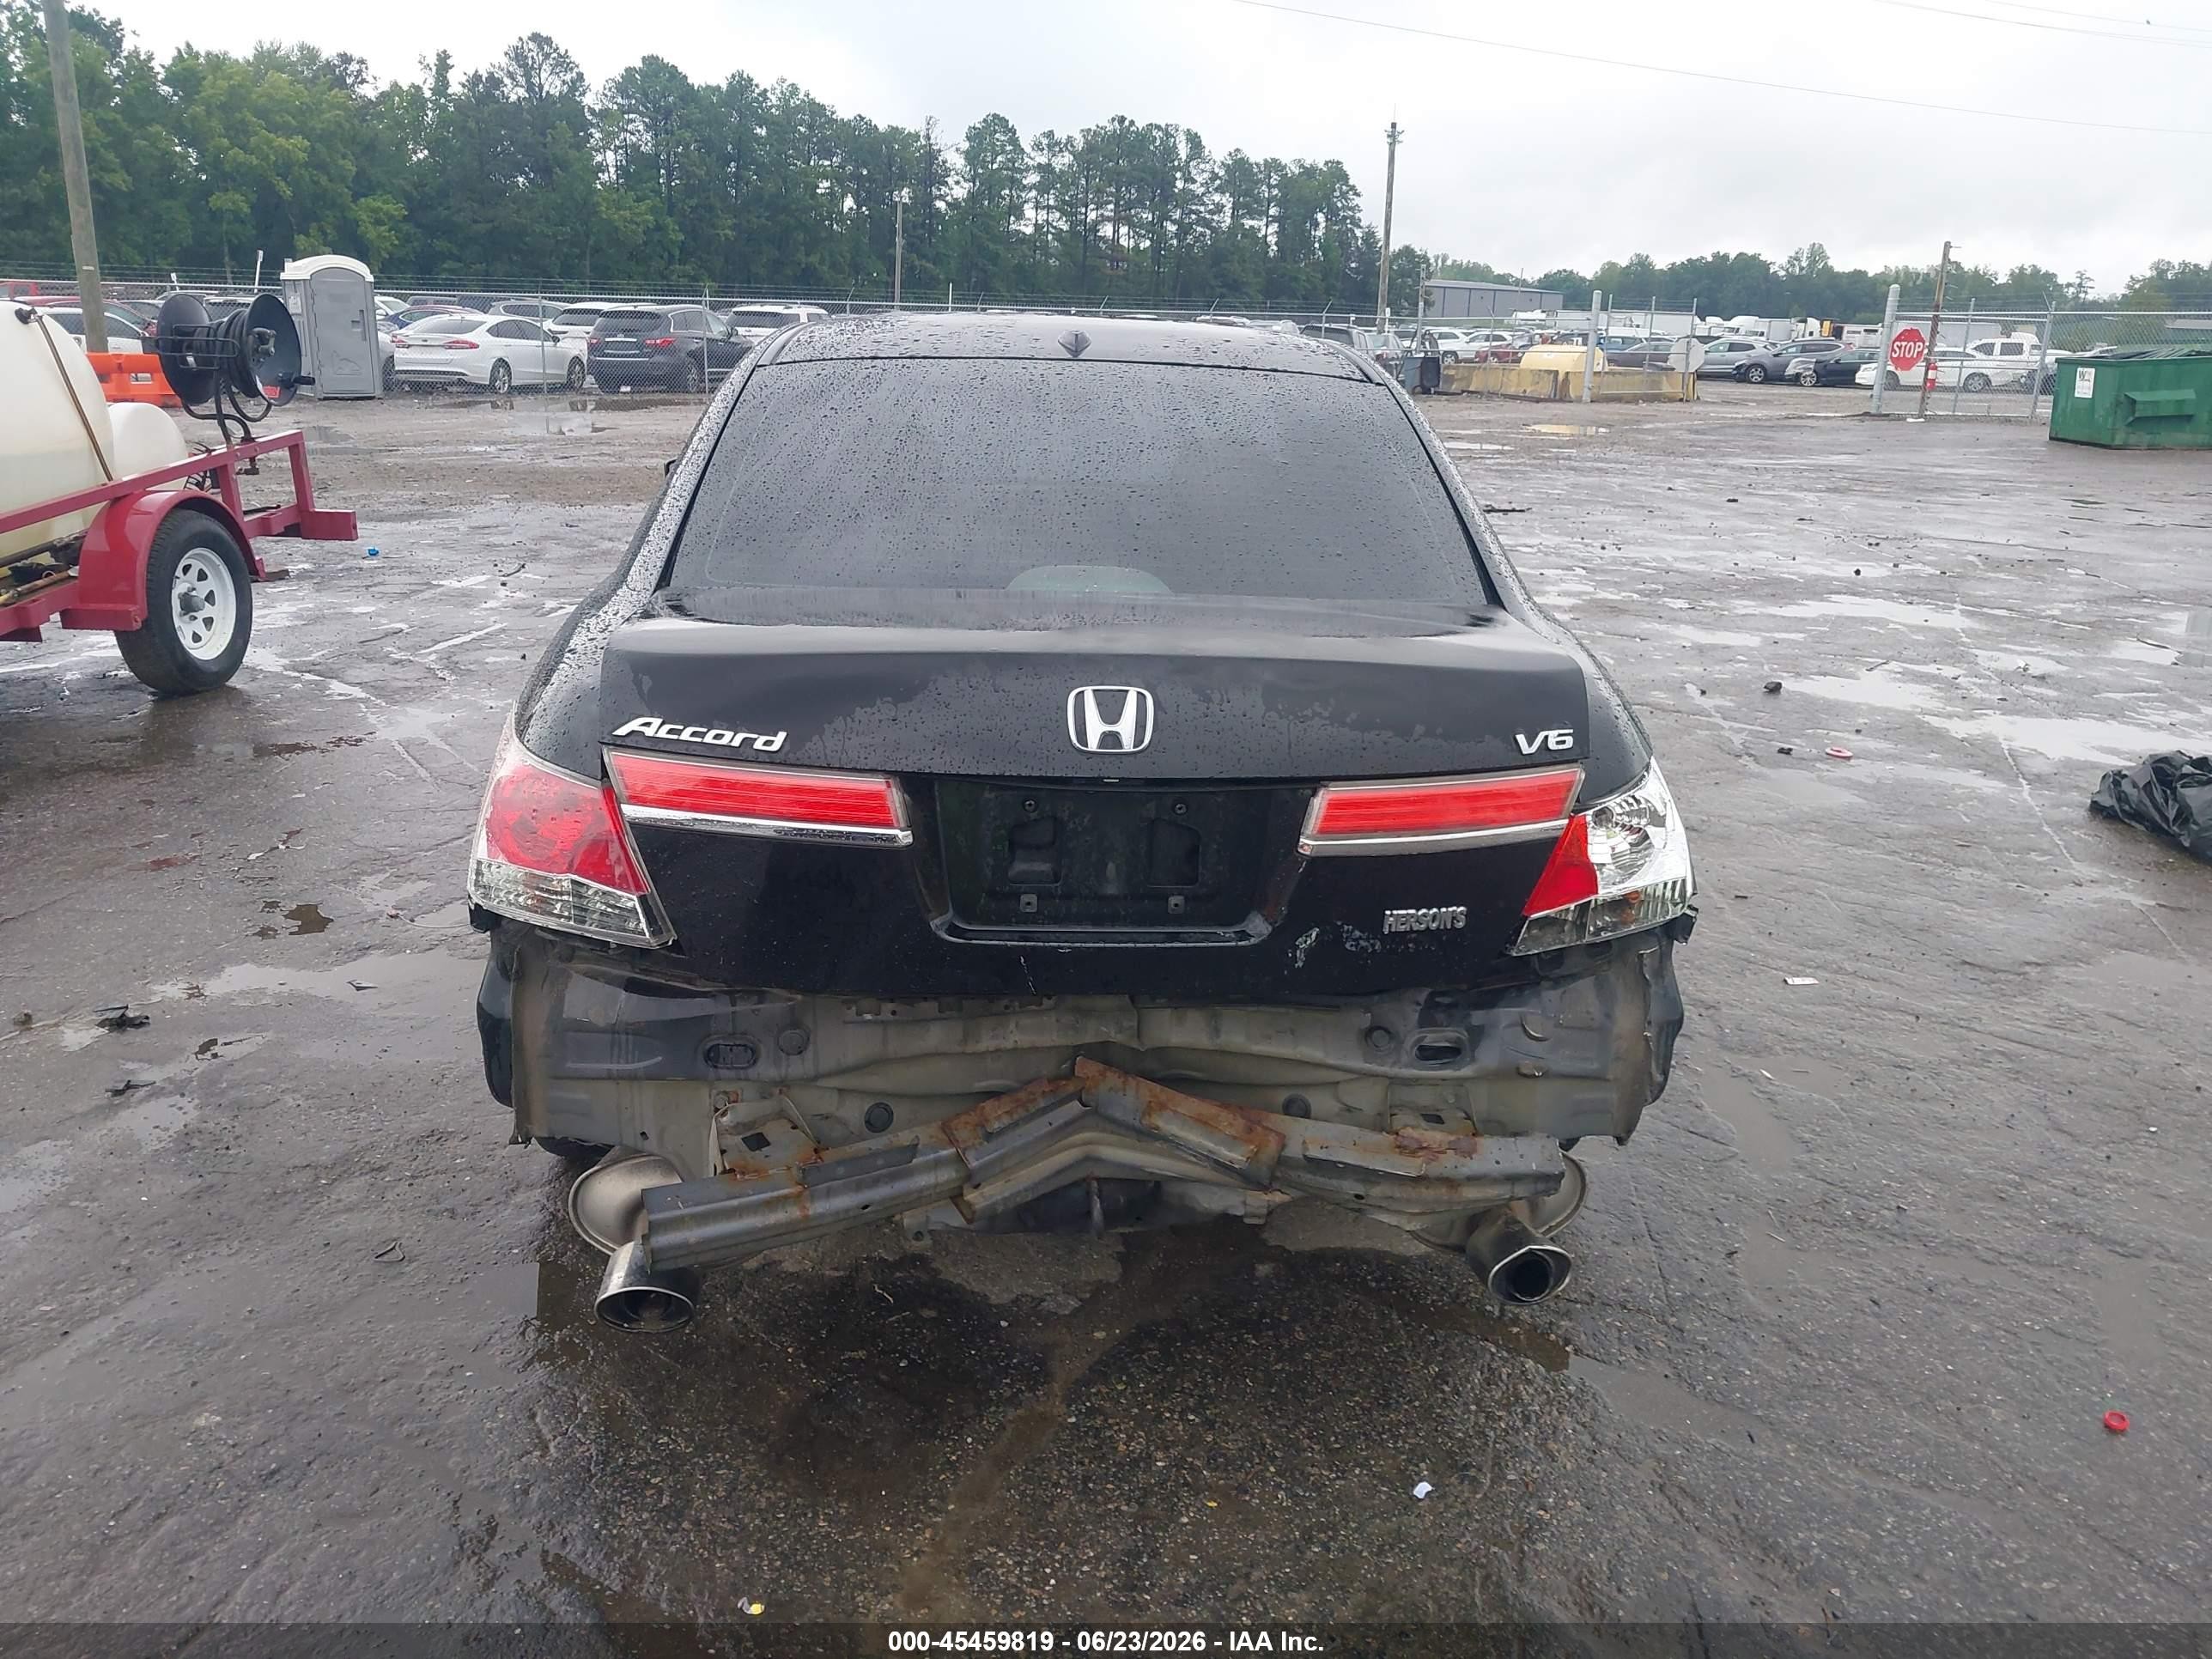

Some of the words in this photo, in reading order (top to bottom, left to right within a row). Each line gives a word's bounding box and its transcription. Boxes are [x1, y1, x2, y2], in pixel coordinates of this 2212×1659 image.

[1892, 341, 1923, 358] STOP
[611, 716, 787, 752] Accord
[1514, 728, 1574, 755] V6
[1382, 906, 1467, 934] HERSON'S
